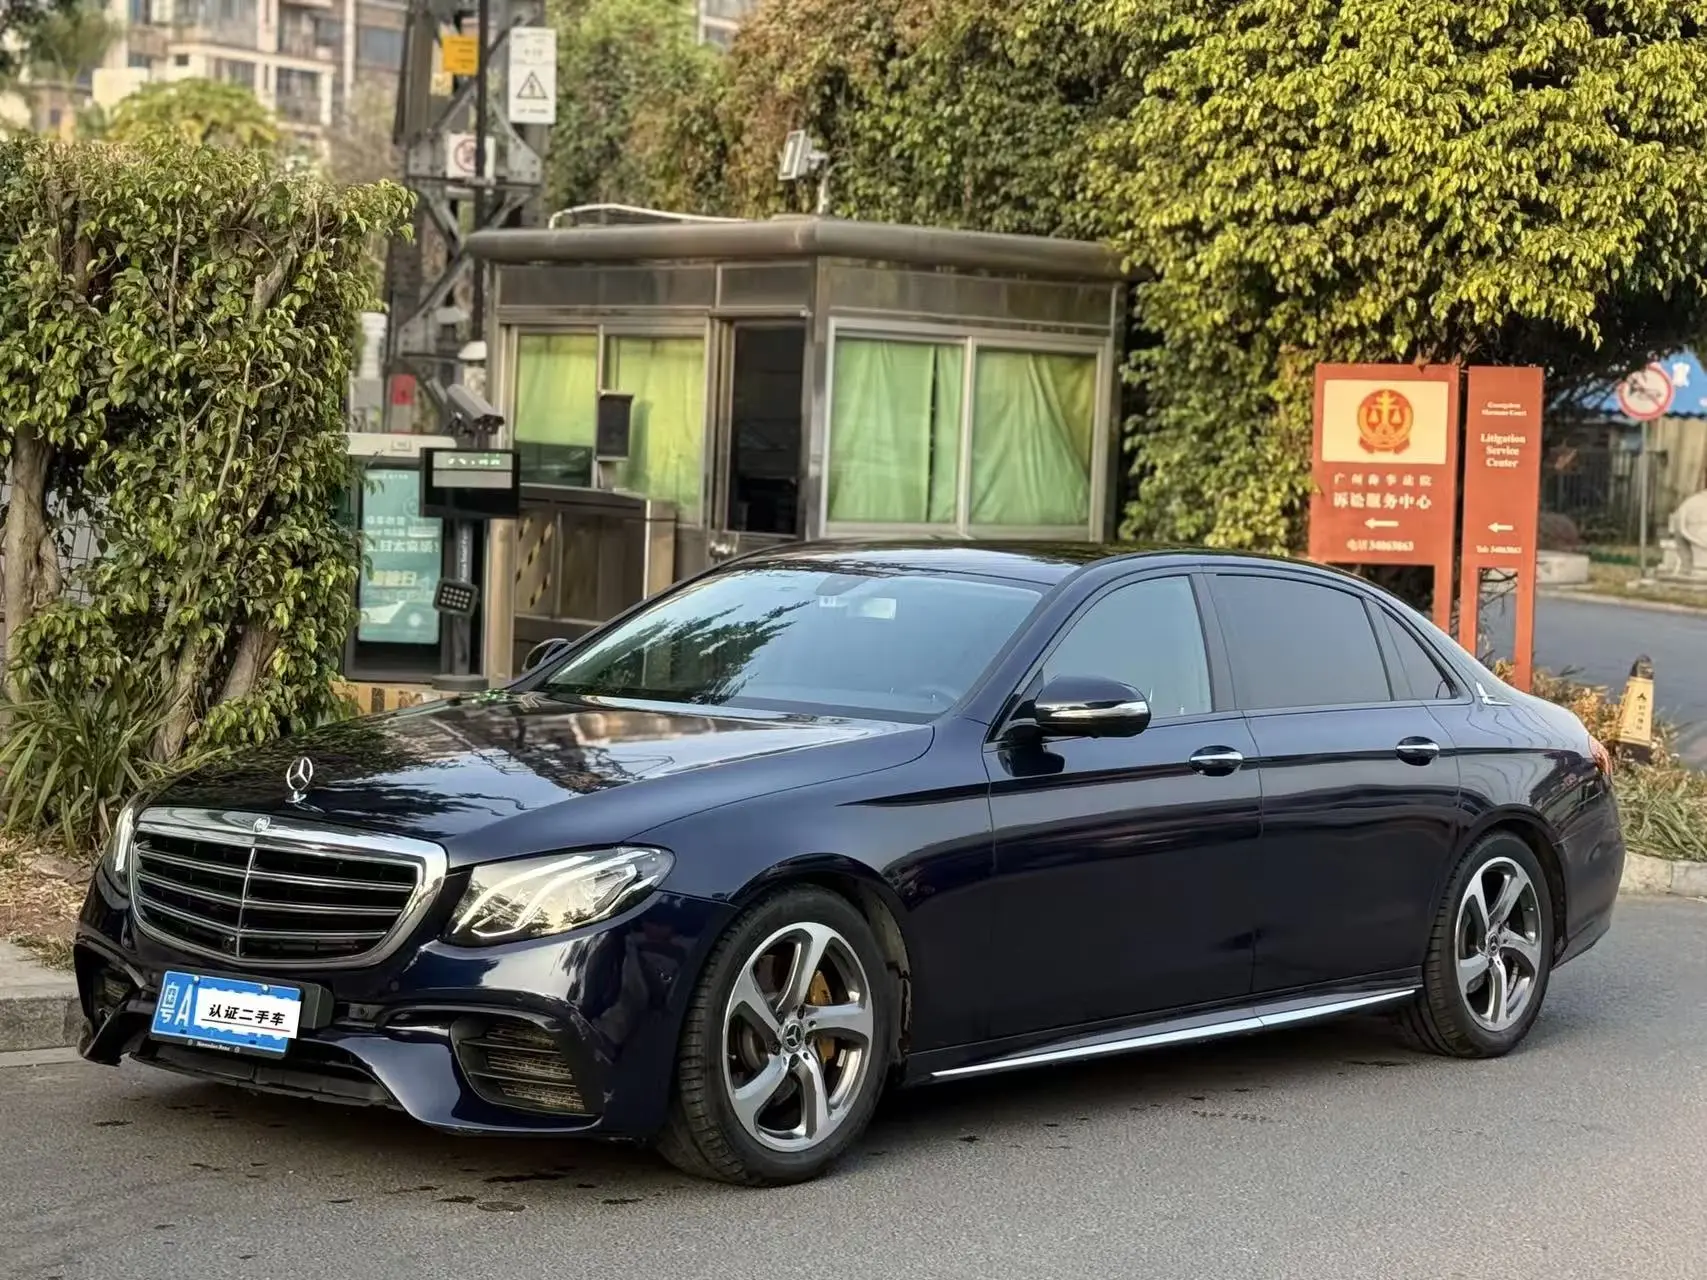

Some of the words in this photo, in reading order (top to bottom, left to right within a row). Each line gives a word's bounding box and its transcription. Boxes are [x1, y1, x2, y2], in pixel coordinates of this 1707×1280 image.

[1480, 433, 1526, 444] Litigation
[1486, 445, 1520, 455] Service
[1486, 457, 1519, 468] Center
[1333, 472, 1432, 487] 广州海事法院
[1333, 491, 1432, 510] 诉讼服务中心
[160, 981, 194, 1027] 粤A
